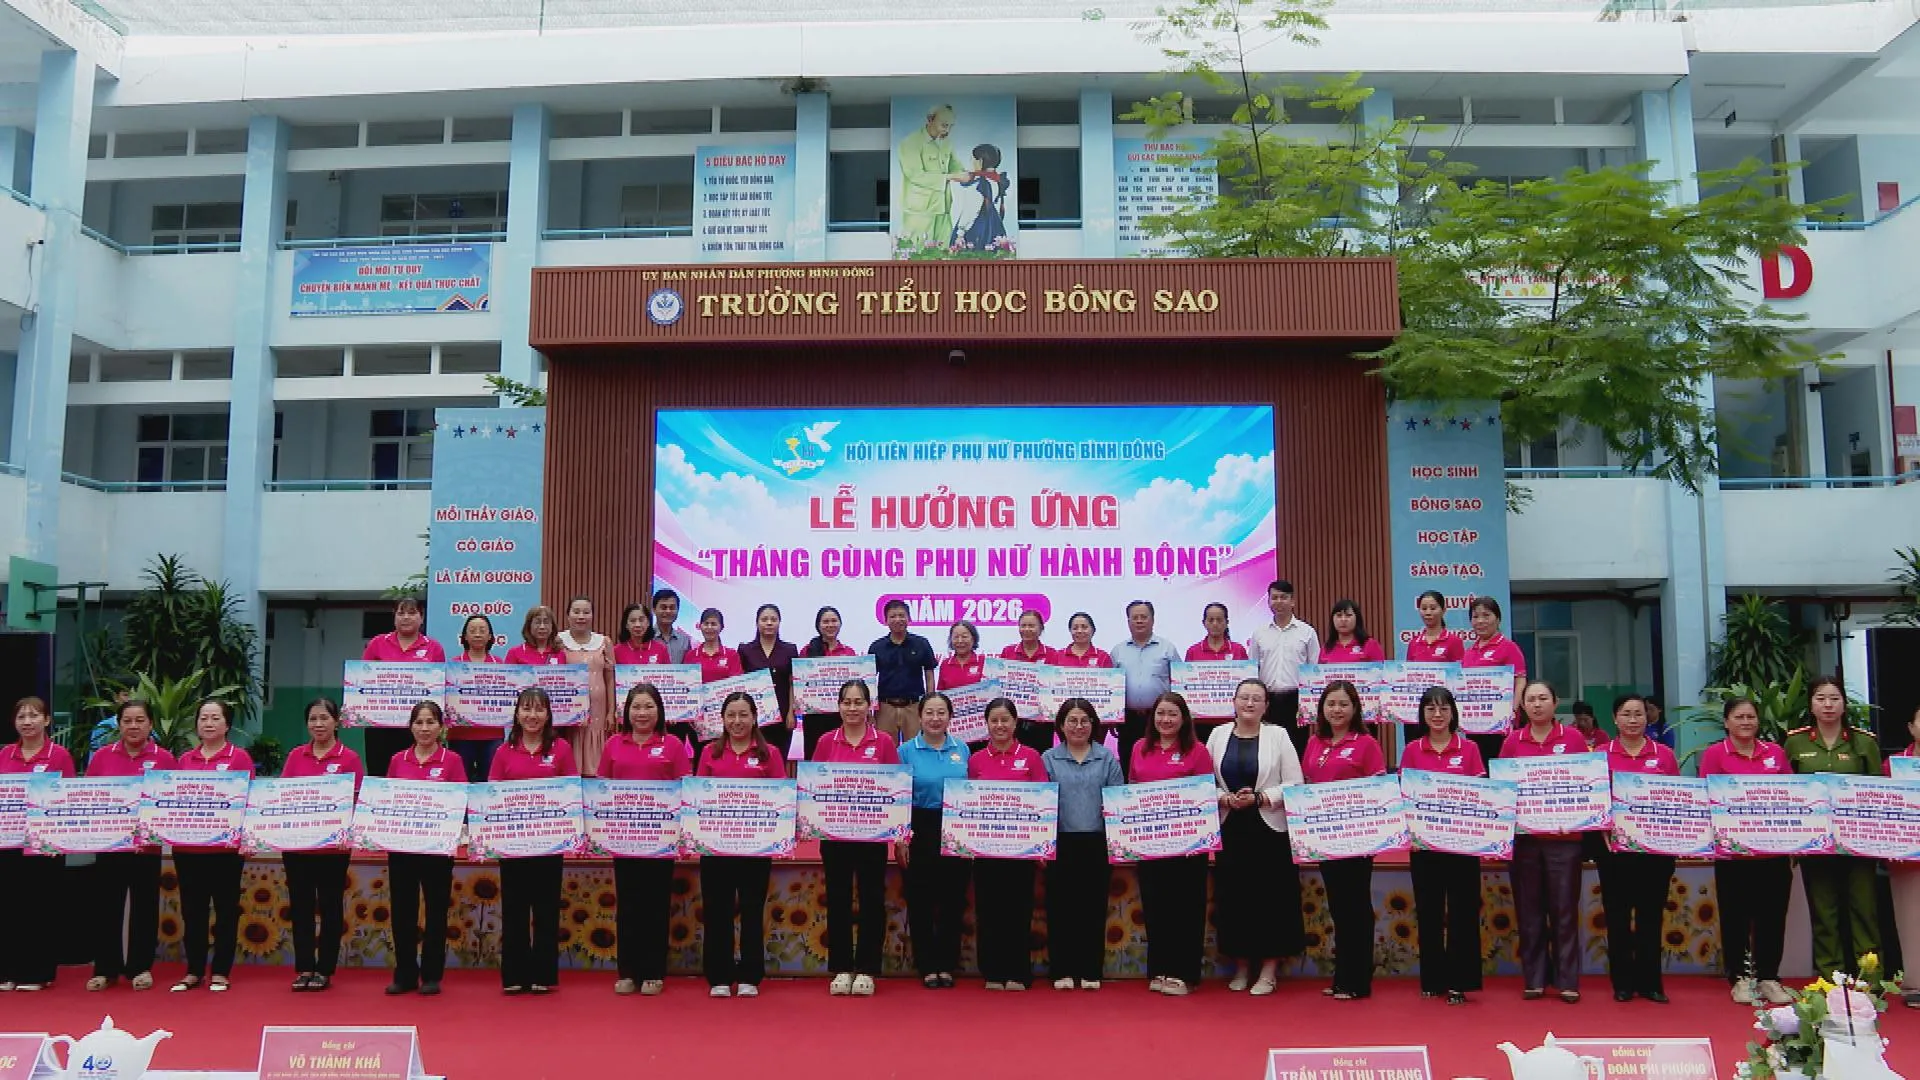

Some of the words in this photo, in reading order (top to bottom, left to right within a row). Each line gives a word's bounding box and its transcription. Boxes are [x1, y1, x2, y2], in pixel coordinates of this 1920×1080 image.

[662, 270, 687, 280] BAN
[1760, 244, 1813, 298] D
[696, 284, 840, 318] TRƯỜNG
[856, 276, 942, 315] TIỂU
[953, 288, 1028, 320] HỌC
[1042, 282, 1138, 314] BÔNG
[1152, 288, 1220, 314] SAO
[845, 441, 874, 464] HỘI
[878, 440, 908, 462] LIÊN
[912, 440, 948, 465] HIỆP
[952, 442, 983, 464] PHỤ
[986, 439, 1010, 460] NỮ
[1013, 439, 1076, 460] PHƯỜNG
[1079, 438, 1118, 460] BÌNH
[1121, 438, 1166, 460] ĐÔNG
[1412, 466, 1444, 481] HỌC
[1446, 466, 1478, 478] SINH
[809, 483, 856, 530] LỄ
[870, 484, 1016, 530] HƯỞNG
[1030, 487, 1120, 530] ỨNG
[1410, 495, 1452, 512] BÔNG
[1454, 498, 1482, 511] SAO
[436, 504, 462, 521] MỖI
[500, 506, 538, 523] GIÁO,
[456, 537, 478, 552] CÔ
[480, 536, 515, 552] GIÁO
[1417, 530, 1450, 547] HỌC
[1452, 528, 1478, 546] TẬP
[820, 543, 905, 578] CÙNG
[915, 546, 977, 583] PHỤ
[987, 542, 1032, 578] NỮ
[1039, 542, 1124, 578] HÀNH
[1410, 560, 1450, 576] SÁNG
[1452, 563, 1484, 579] TẠO,
[436, 568, 452, 583] LÀ
[454, 566, 481, 583] TẤM
[484, 569, 534, 583] GƯƠNG
[451, 602, 480, 617] ĐẠO
[483, 600, 512, 615] ĐỨC
[903, 594, 956, 624] NĂM
[961, 598, 1024, 622] 2026
[289, 1053, 306, 1070] VÕ
[309, 1053, 352, 1069] THÀNH
[1347, 1068, 1375, 1080] THU
[1377, 1067, 1422, 1080] TRANG
